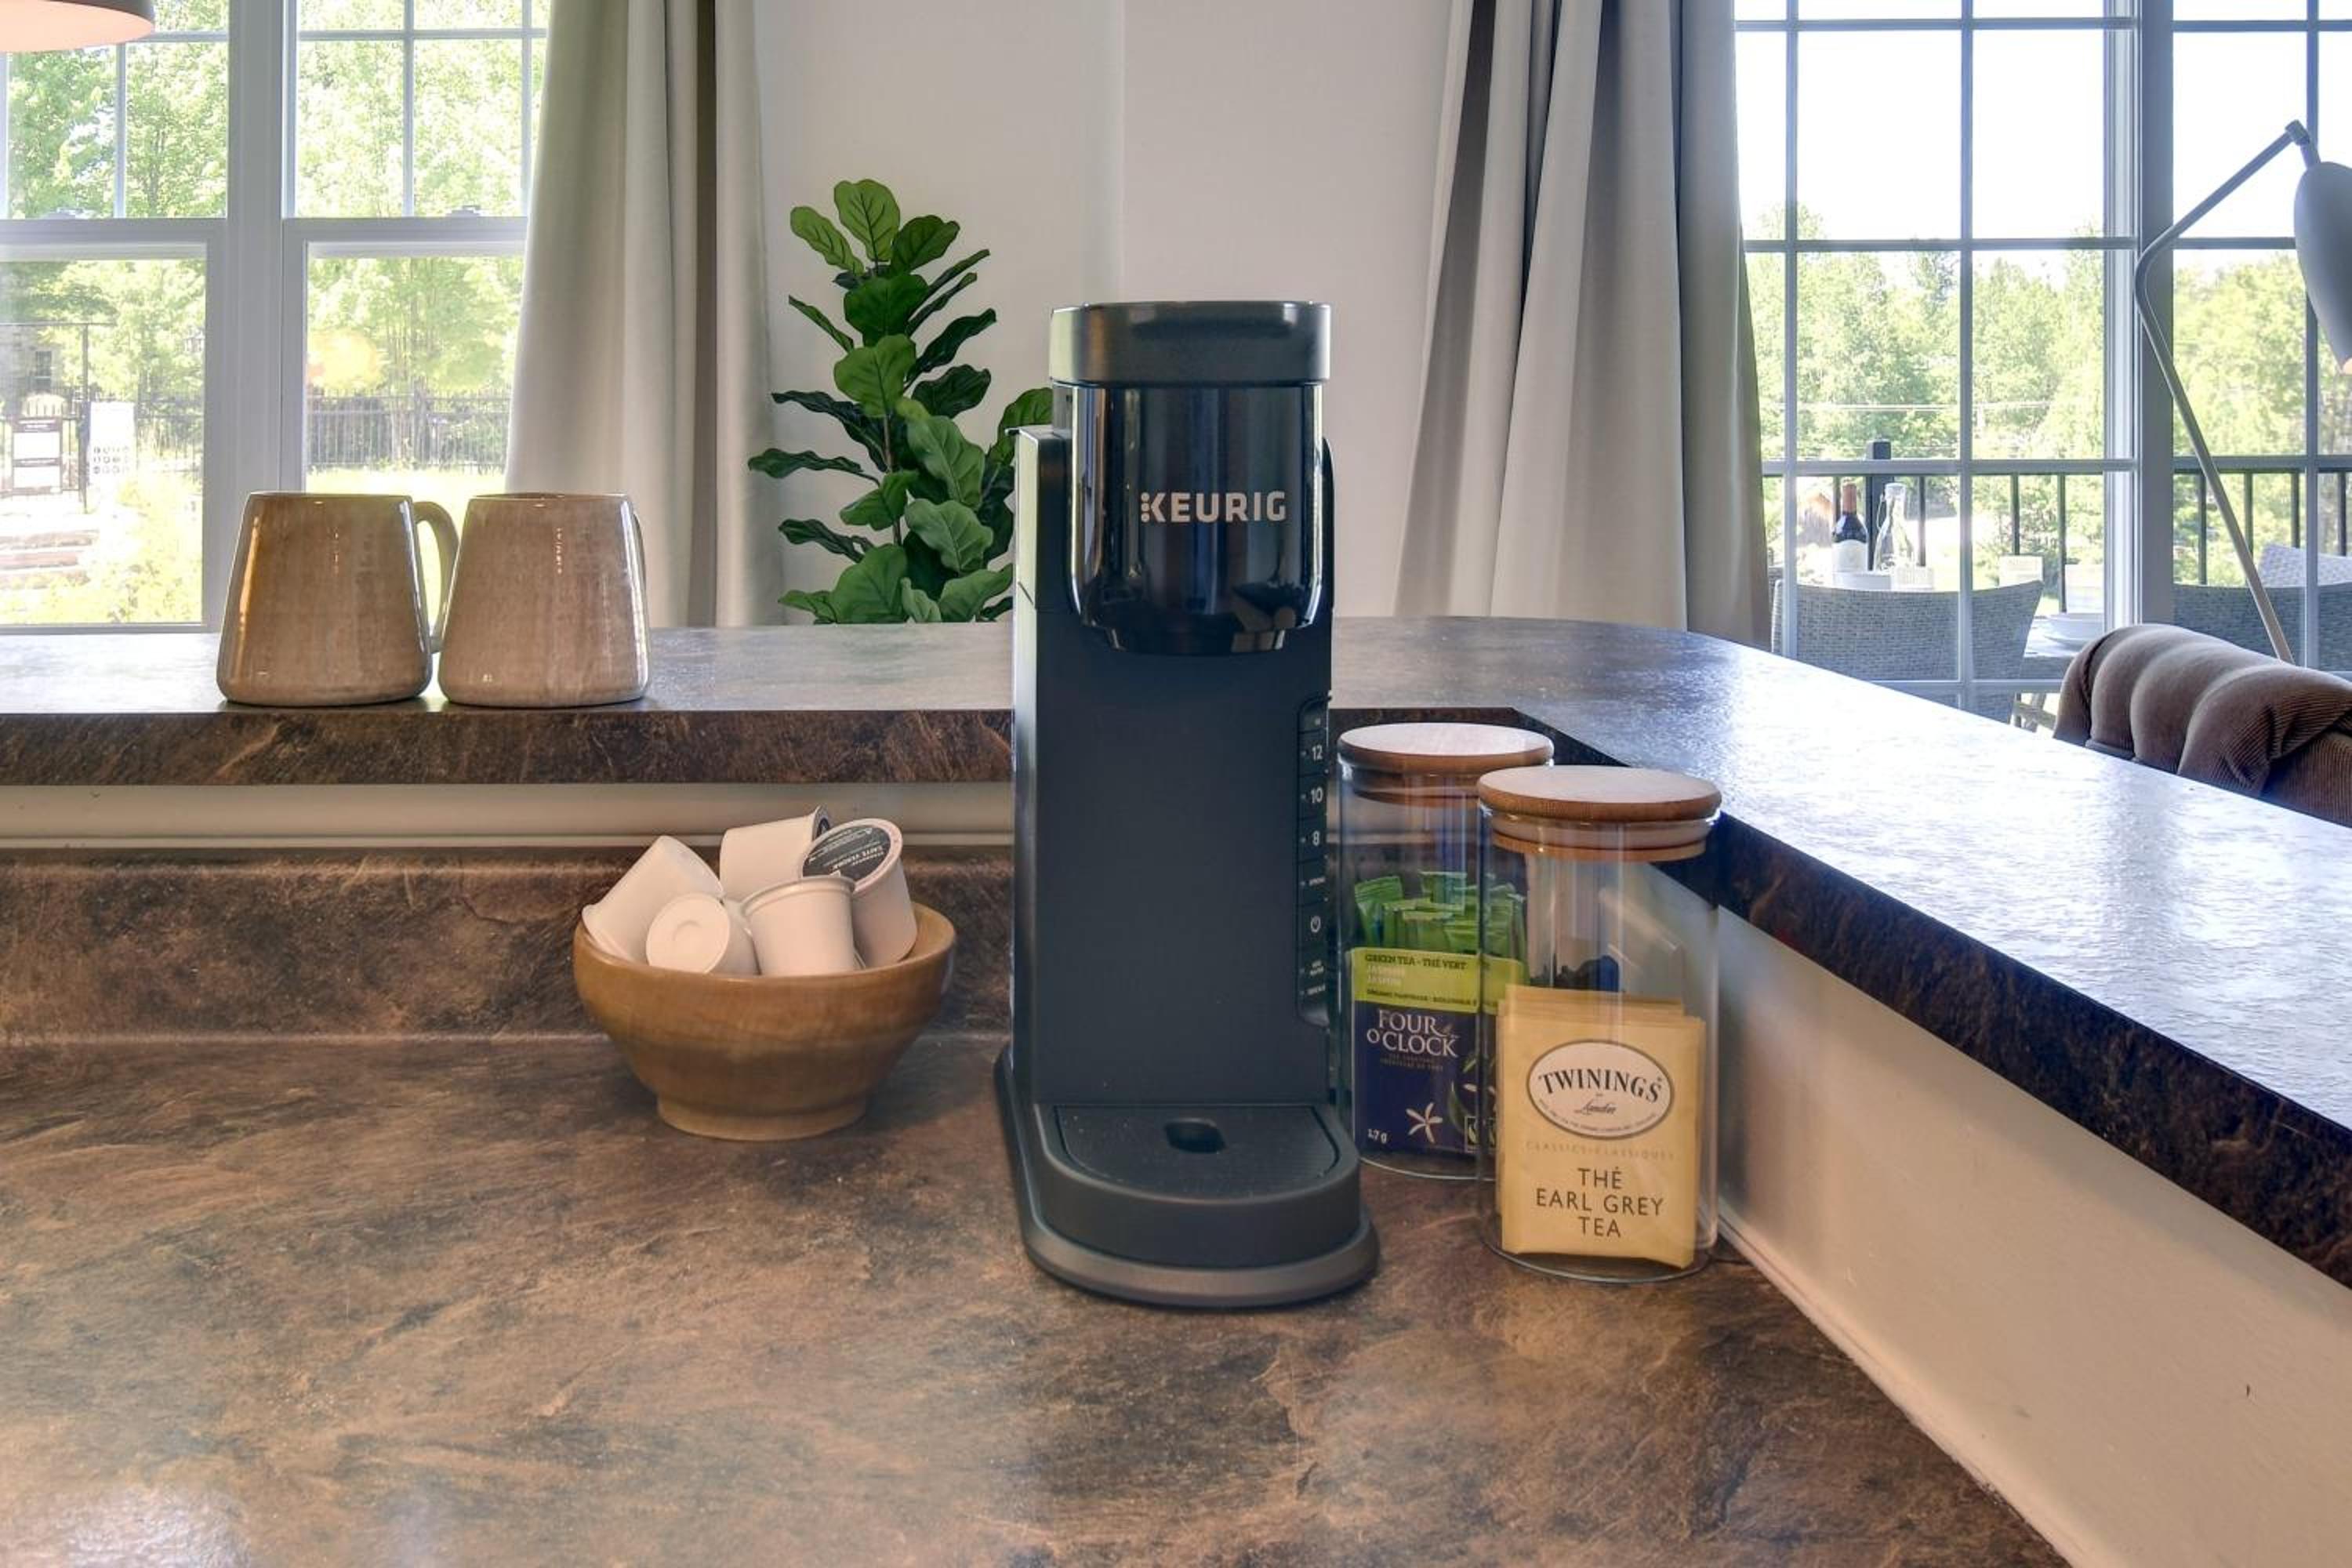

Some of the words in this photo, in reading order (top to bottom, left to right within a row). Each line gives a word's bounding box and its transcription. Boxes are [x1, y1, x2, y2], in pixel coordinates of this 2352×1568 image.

[1141, 491, 1286, 523] KEURIG
[1312, 745, 1323, 761] 12
[1310, 786, 1323, 804] 10
[1312, 830, 1321, 847] 8
[1365, 953, 1396, 964] GREEN
[1397, 955, 1416, 966] TEA
[1442, 959, 1468, 971] VERT
[1378, 1009, 1448, 1038] FOUR
[1367, 1028, 1459, 1058] O'CLOCK
[1538, 1068, 1662, 1104] TWININGS
[1535, 1187, 1593, 1212] EARL
[1603, 1193, 1664, 1217] GREY
[1577, 1216, 1621, 1238] TEA
